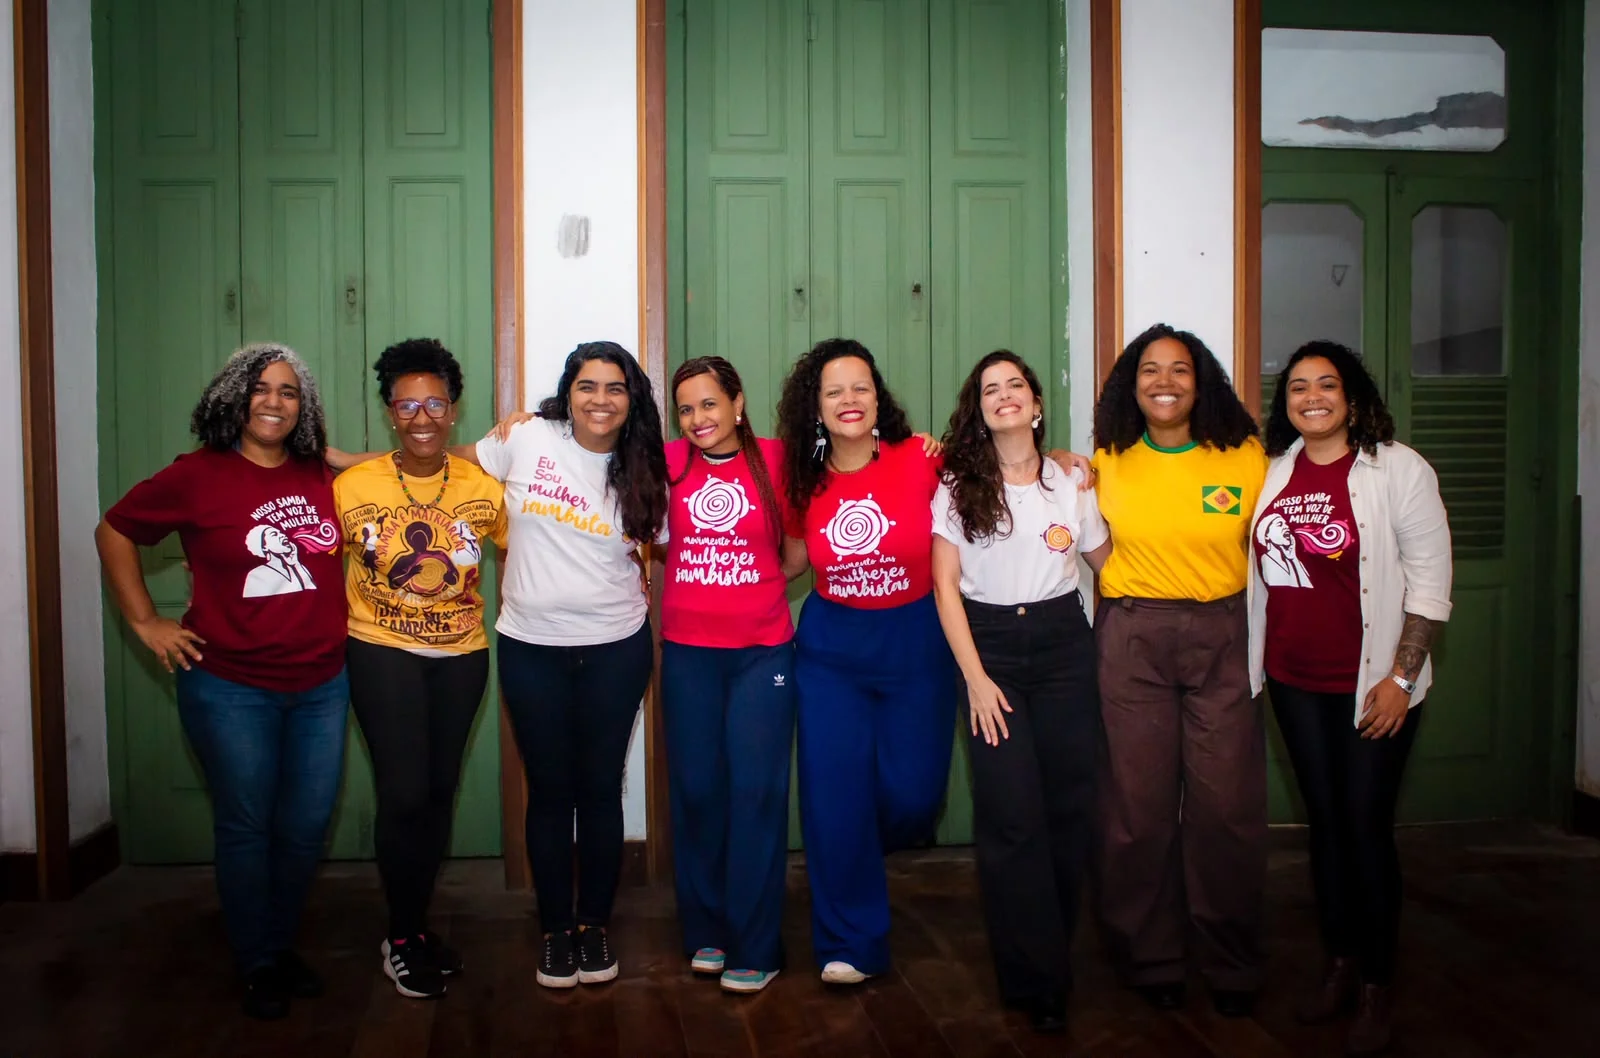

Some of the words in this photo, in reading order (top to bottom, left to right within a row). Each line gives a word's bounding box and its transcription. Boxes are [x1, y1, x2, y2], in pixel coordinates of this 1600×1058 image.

[537, 456, 555, 470] Eu
[534, 469, 561, 483] Sou
[1274, 496, 1302, 508] NOSSO
[1303, 493, 1331, 503] SAMBA
[250, 501, 276, 521] NOSSO
[276, 496, 307, 507] SAMBA
[266, 509, 286, 524] TEM
[286, 506, 304, 515] VOZ
[306, 506, 317, 514] DE
[352, 507, 375, 519] LEGADO
[1283, 505, 1302, 514] TEM
[1306, 504, 1321, 513] VOZ
[1323, 504, 1335, 514] DE
[280, 515, 320, 531] MULHER
[347, 515, 375, 531] CONTINUA
[521, 498, 613, 536] sambista
[1289, 514, 1329, 524] MULHER
[376, 520, 401, 557] SAMBA
[732, 536, 748, 546] das
[879, 554, 896, 563] das
[675, 561, 761, 586] sambistas
